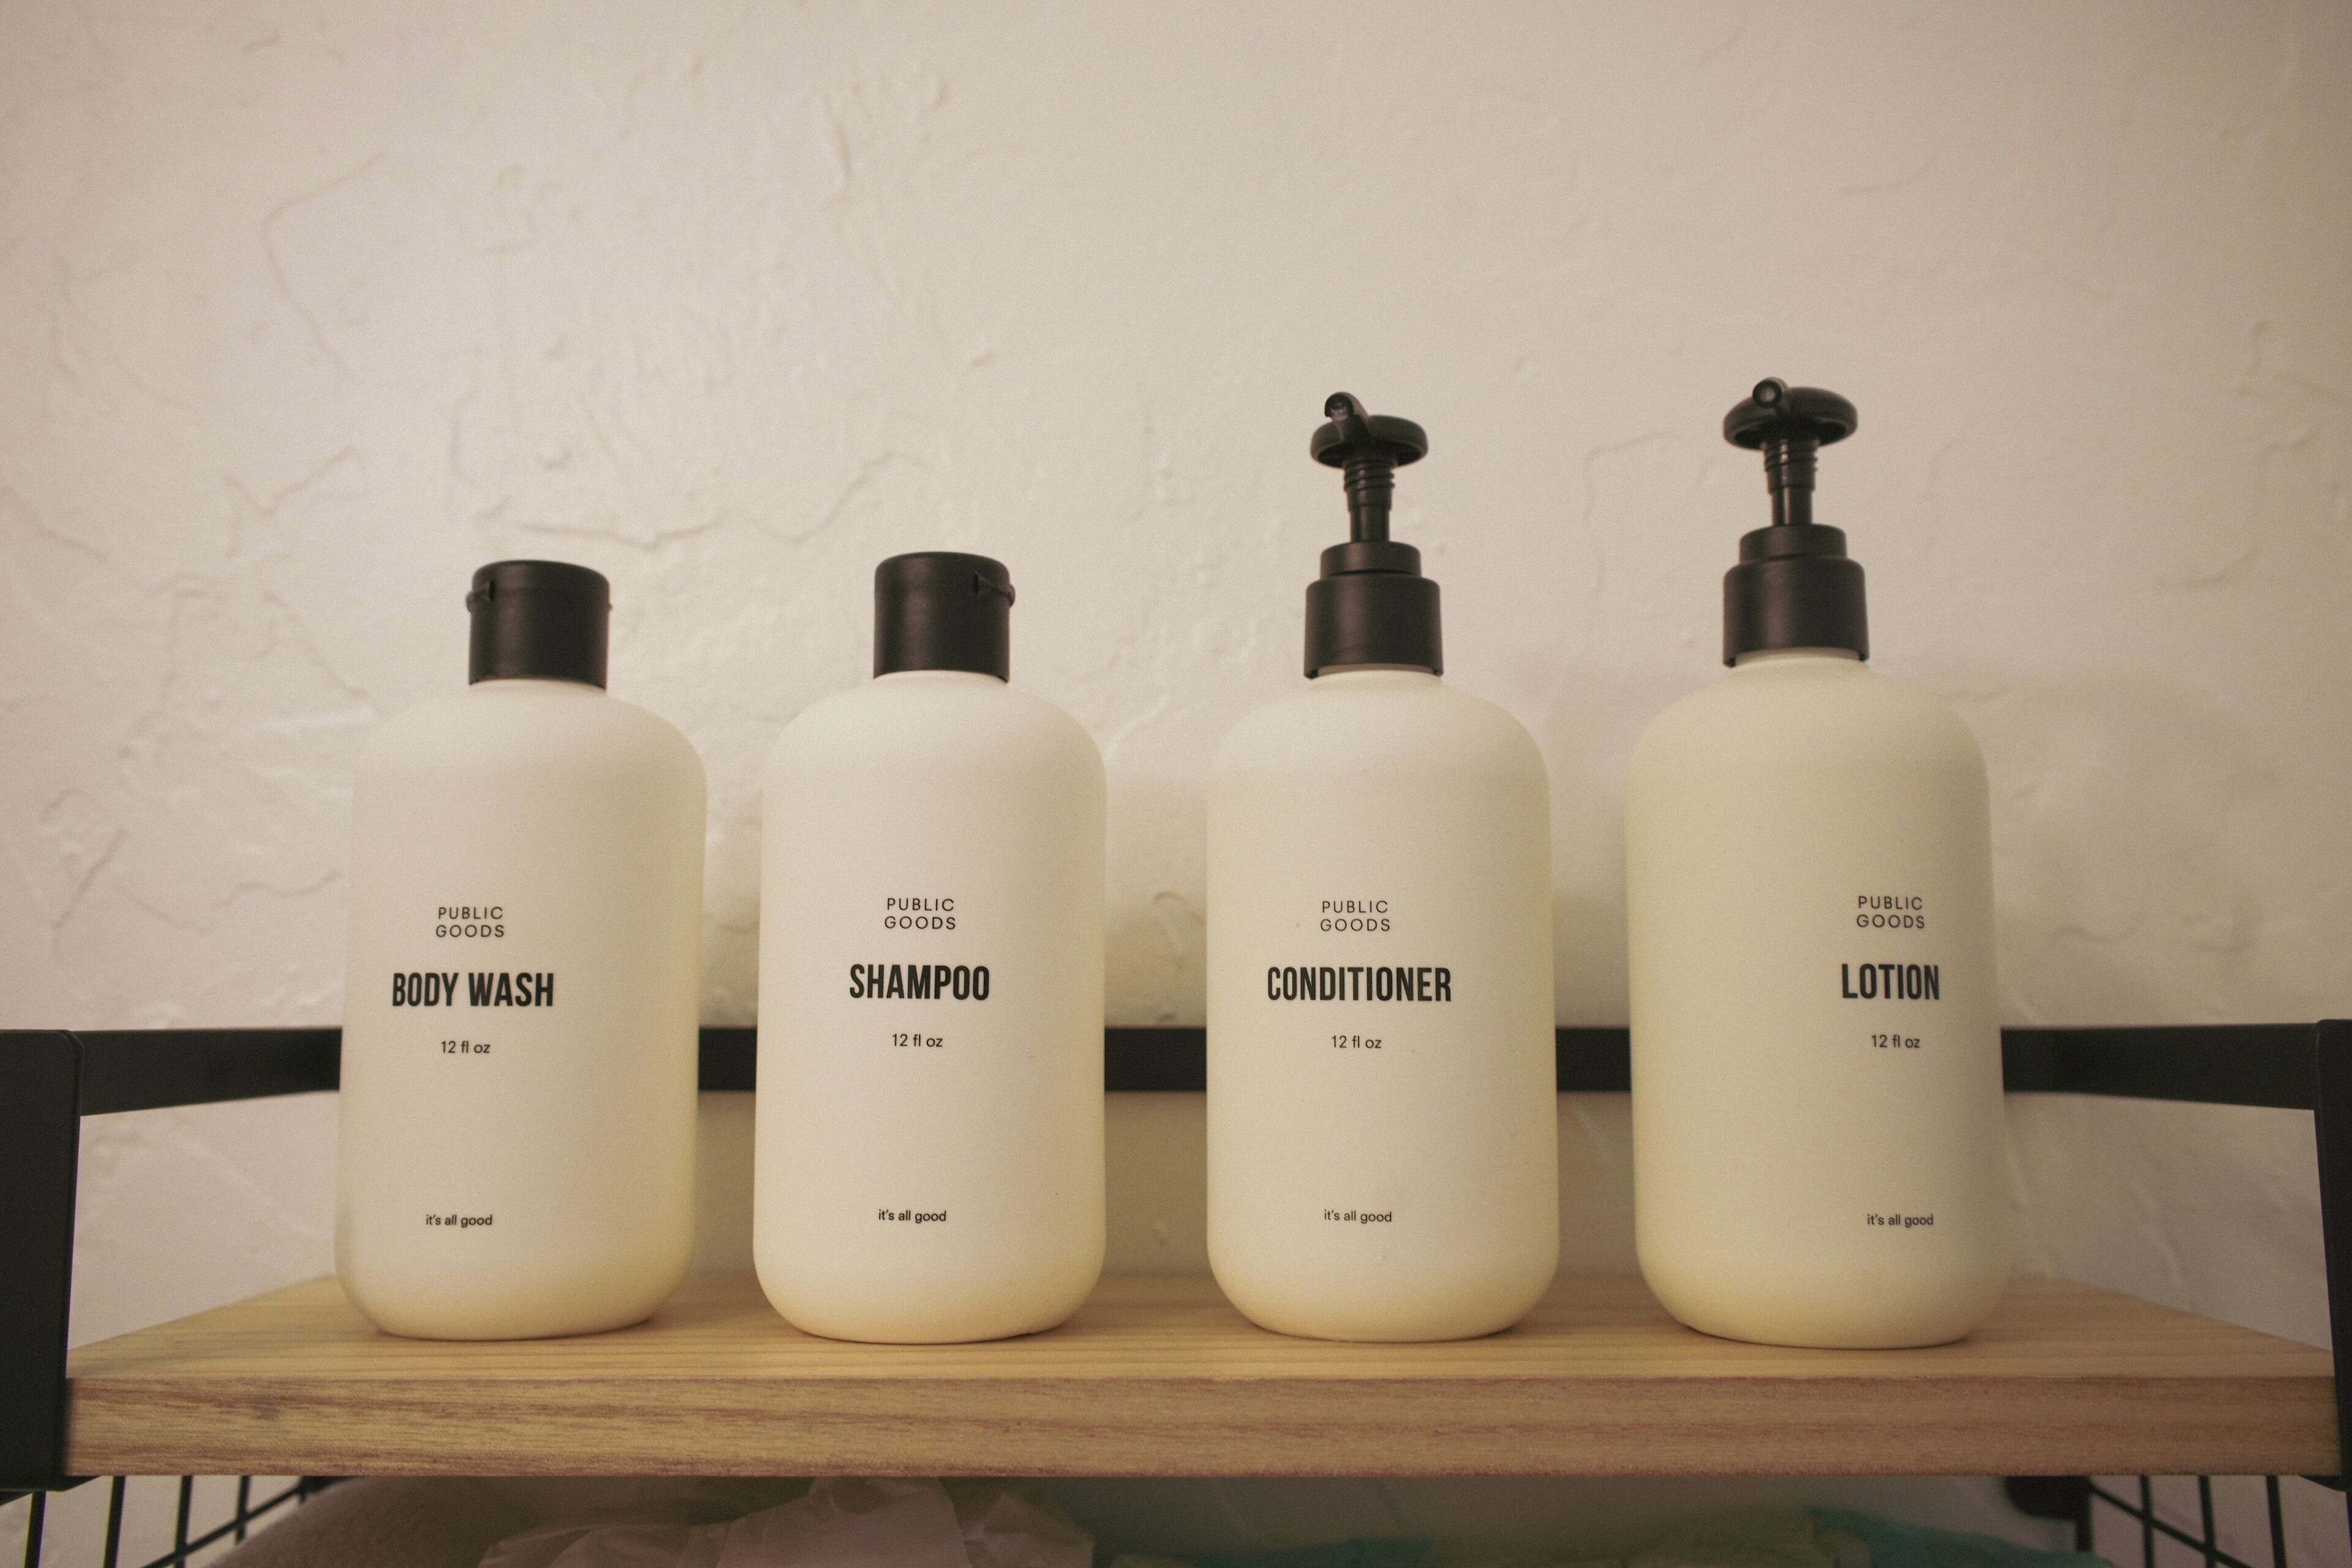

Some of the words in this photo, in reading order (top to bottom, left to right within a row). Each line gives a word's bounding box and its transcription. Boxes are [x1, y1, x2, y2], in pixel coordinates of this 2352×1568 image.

[887, 897, 954, 912] PUBLIC
[1322, 900, 1388, 914] PUBLIC
[1858, 895, 1923, 911] PUBLIC
[438, 906, 503, 920] PUBLIC
[884, 915, 956, 930] GOODS
[1320, 918, 1390, 932] GOODS
[1856, 914, 1925, 929] GOODS
[435, 924, 505, 938] GOODS
[391, 971, 460, 1008] BODY
[467, 971, 554, 1008] WASH
[849, 963, 990, 1001] SHAMPOO
[1267, 966, 1452, 1003] CONDITIONER
[1841, 963, 1940, 1001] LOTION
[440, 1040, 456, 1054] 12
[460, 1040, 470, 1054] fl
[473, 1044, 491, 1054] oz
[892, 1033, 908, 1047] 12
[912, 1033, 922, 1047] fl
[925, 1037, 943, 1048] oz
[1332, 1035, 1348, 1049] 12
[1351, 1035, 1360, 1049] fl
[1365, 1039, 1382, 1049] oz
[1871, 1033, 1888, 1049] 12
[1891, 1034, 1901, 1049] fl
[1904, 1038, 1921, 1049] oz
[426, 1213, 442, 1226] it's
[444, 1213, 458, 1226] all
[460, 1213, 493, 1229] good
[878, 1208, 895, 1221] it's
[898, 1209, 911, 1221] all
[914, 1210, 947, 1224] good
[1324, 1208, 1340, 1221] it's
[1343, 1210, 1357, 1222] all
[1360, 1210, 1392, 1224] good
[1867, 1213, 1885, 1226] it's
[1888, 1213, 1901, 1226] all
[1904, 1213, 1934, 1229] good
